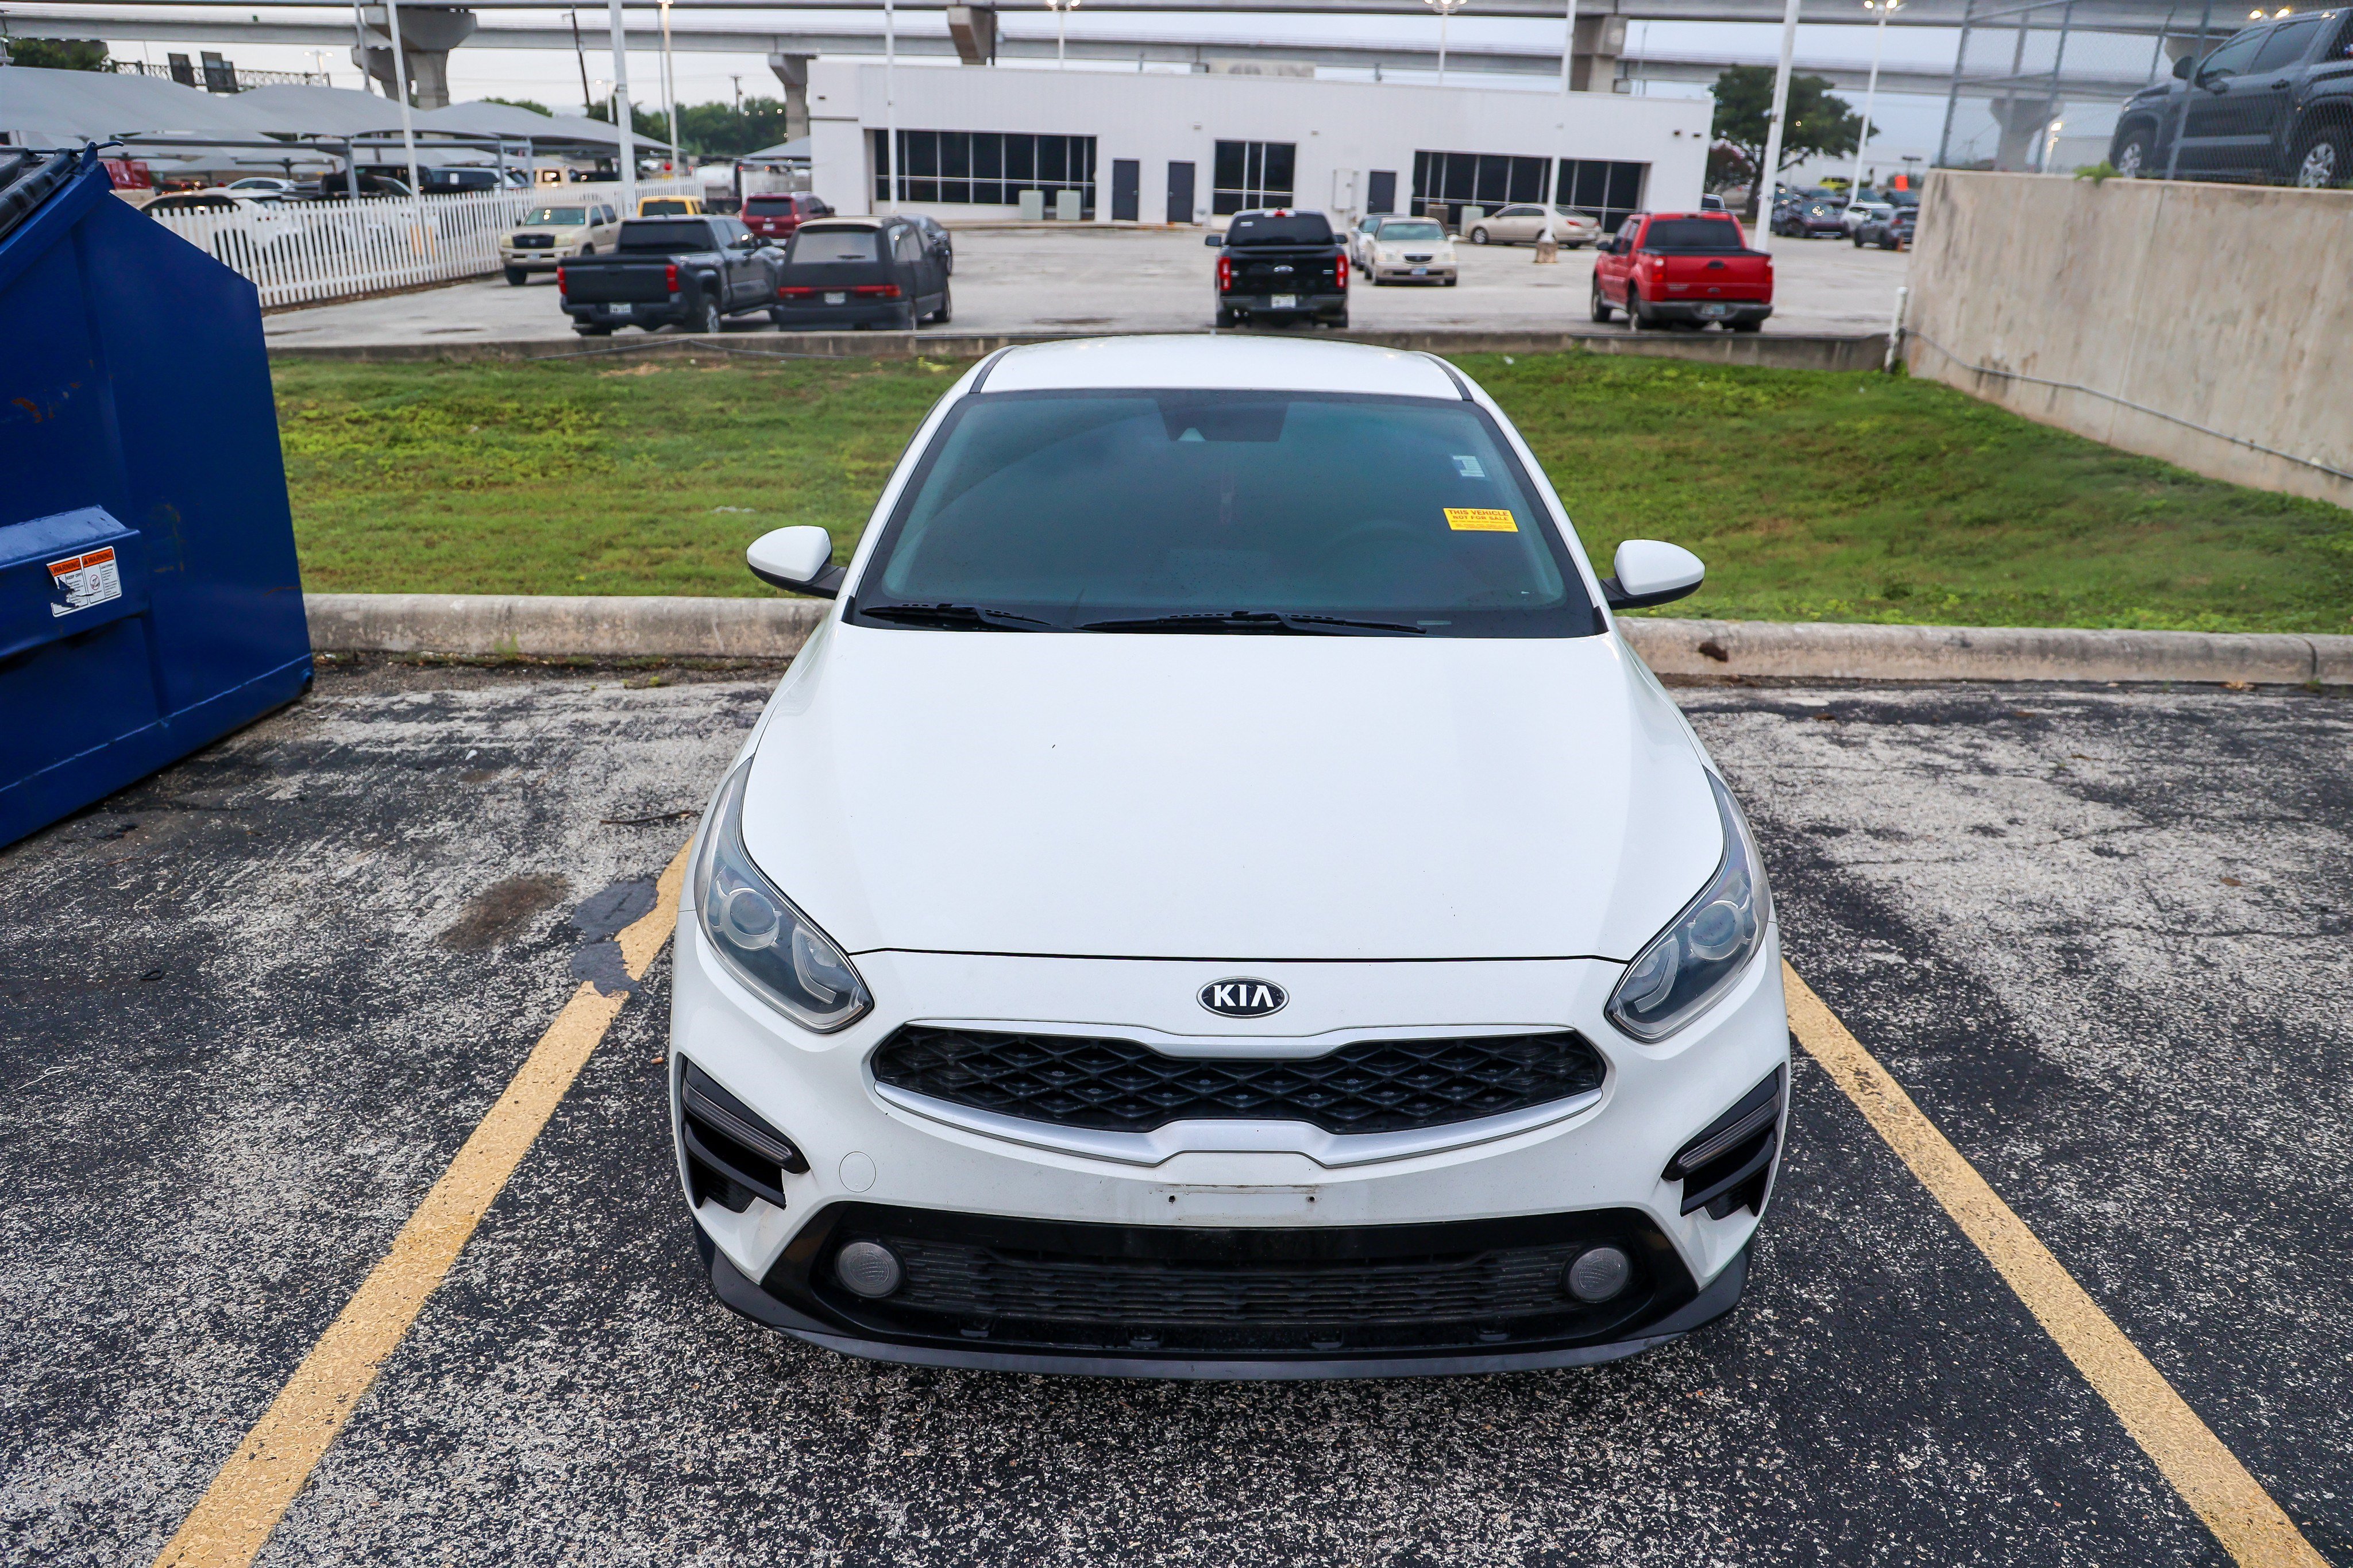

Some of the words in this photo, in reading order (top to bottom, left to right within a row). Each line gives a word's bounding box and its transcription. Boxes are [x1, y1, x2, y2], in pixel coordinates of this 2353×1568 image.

[88, 551, 113, 563] WARNING
[53, 561, 80, 573] WARNING
[1213, 984, 1274, 1007] KIA
